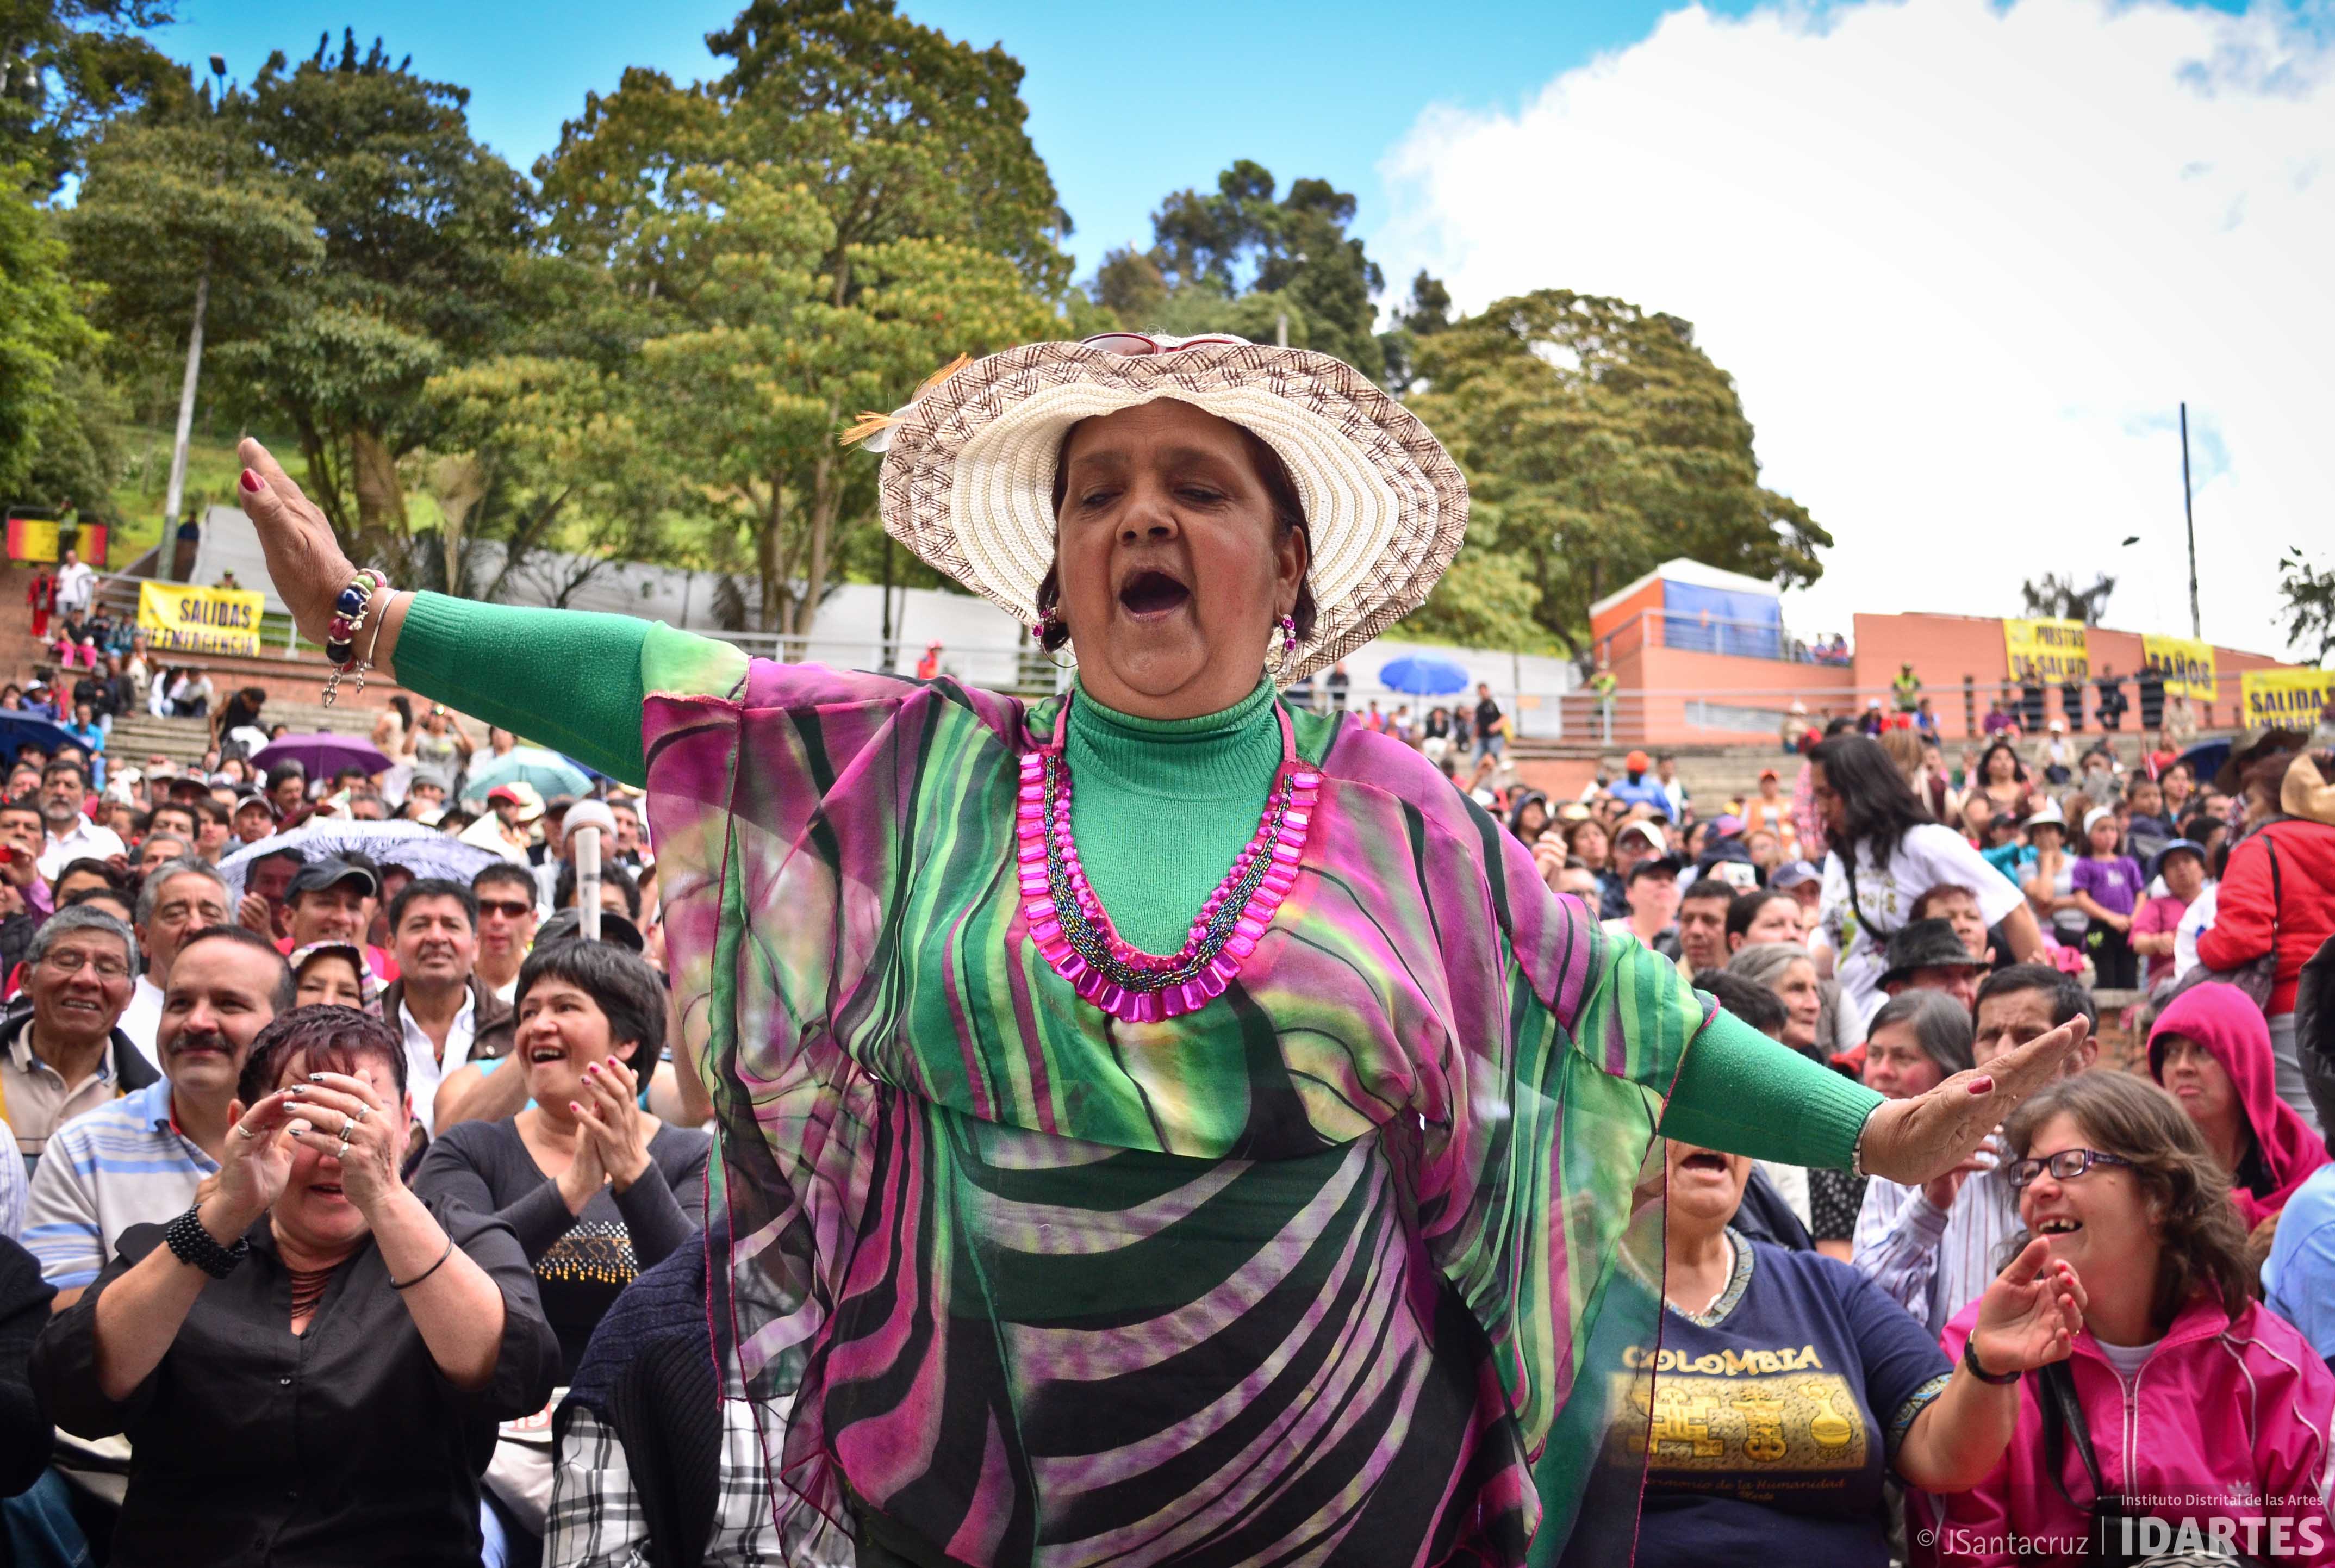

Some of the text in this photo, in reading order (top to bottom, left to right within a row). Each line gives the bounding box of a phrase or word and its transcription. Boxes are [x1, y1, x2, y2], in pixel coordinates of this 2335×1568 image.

[179, 598, 251, 628] SALIDAS
[1622, 1345, 1823, 1376] COLOMBIA
[1757, 1477, 1845, 1489] Humanidad
